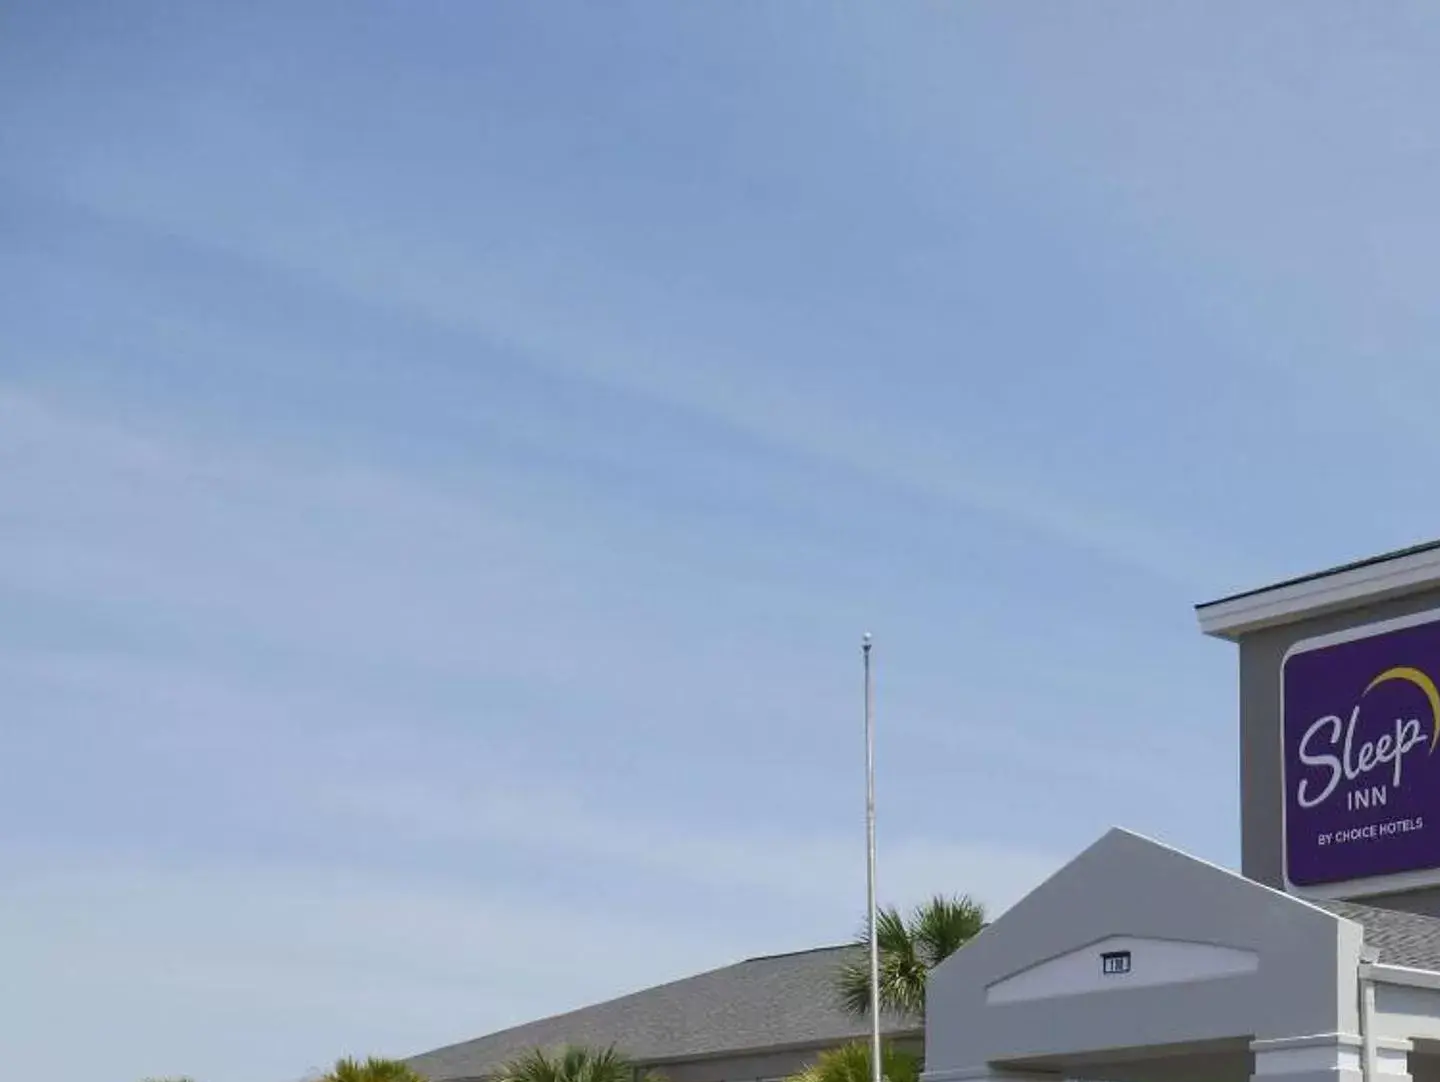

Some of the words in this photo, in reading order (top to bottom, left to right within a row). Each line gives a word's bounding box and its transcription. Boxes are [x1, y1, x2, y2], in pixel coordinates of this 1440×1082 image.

[1298, 705, 1428, 808] Sleep
[1347, 785, 1387, 811] INN
[1318, 832, 1332, 846] BY
[1335, 824, 1378, 843] CHOICE
[1380, 816, 1423, 836] HOTELS
